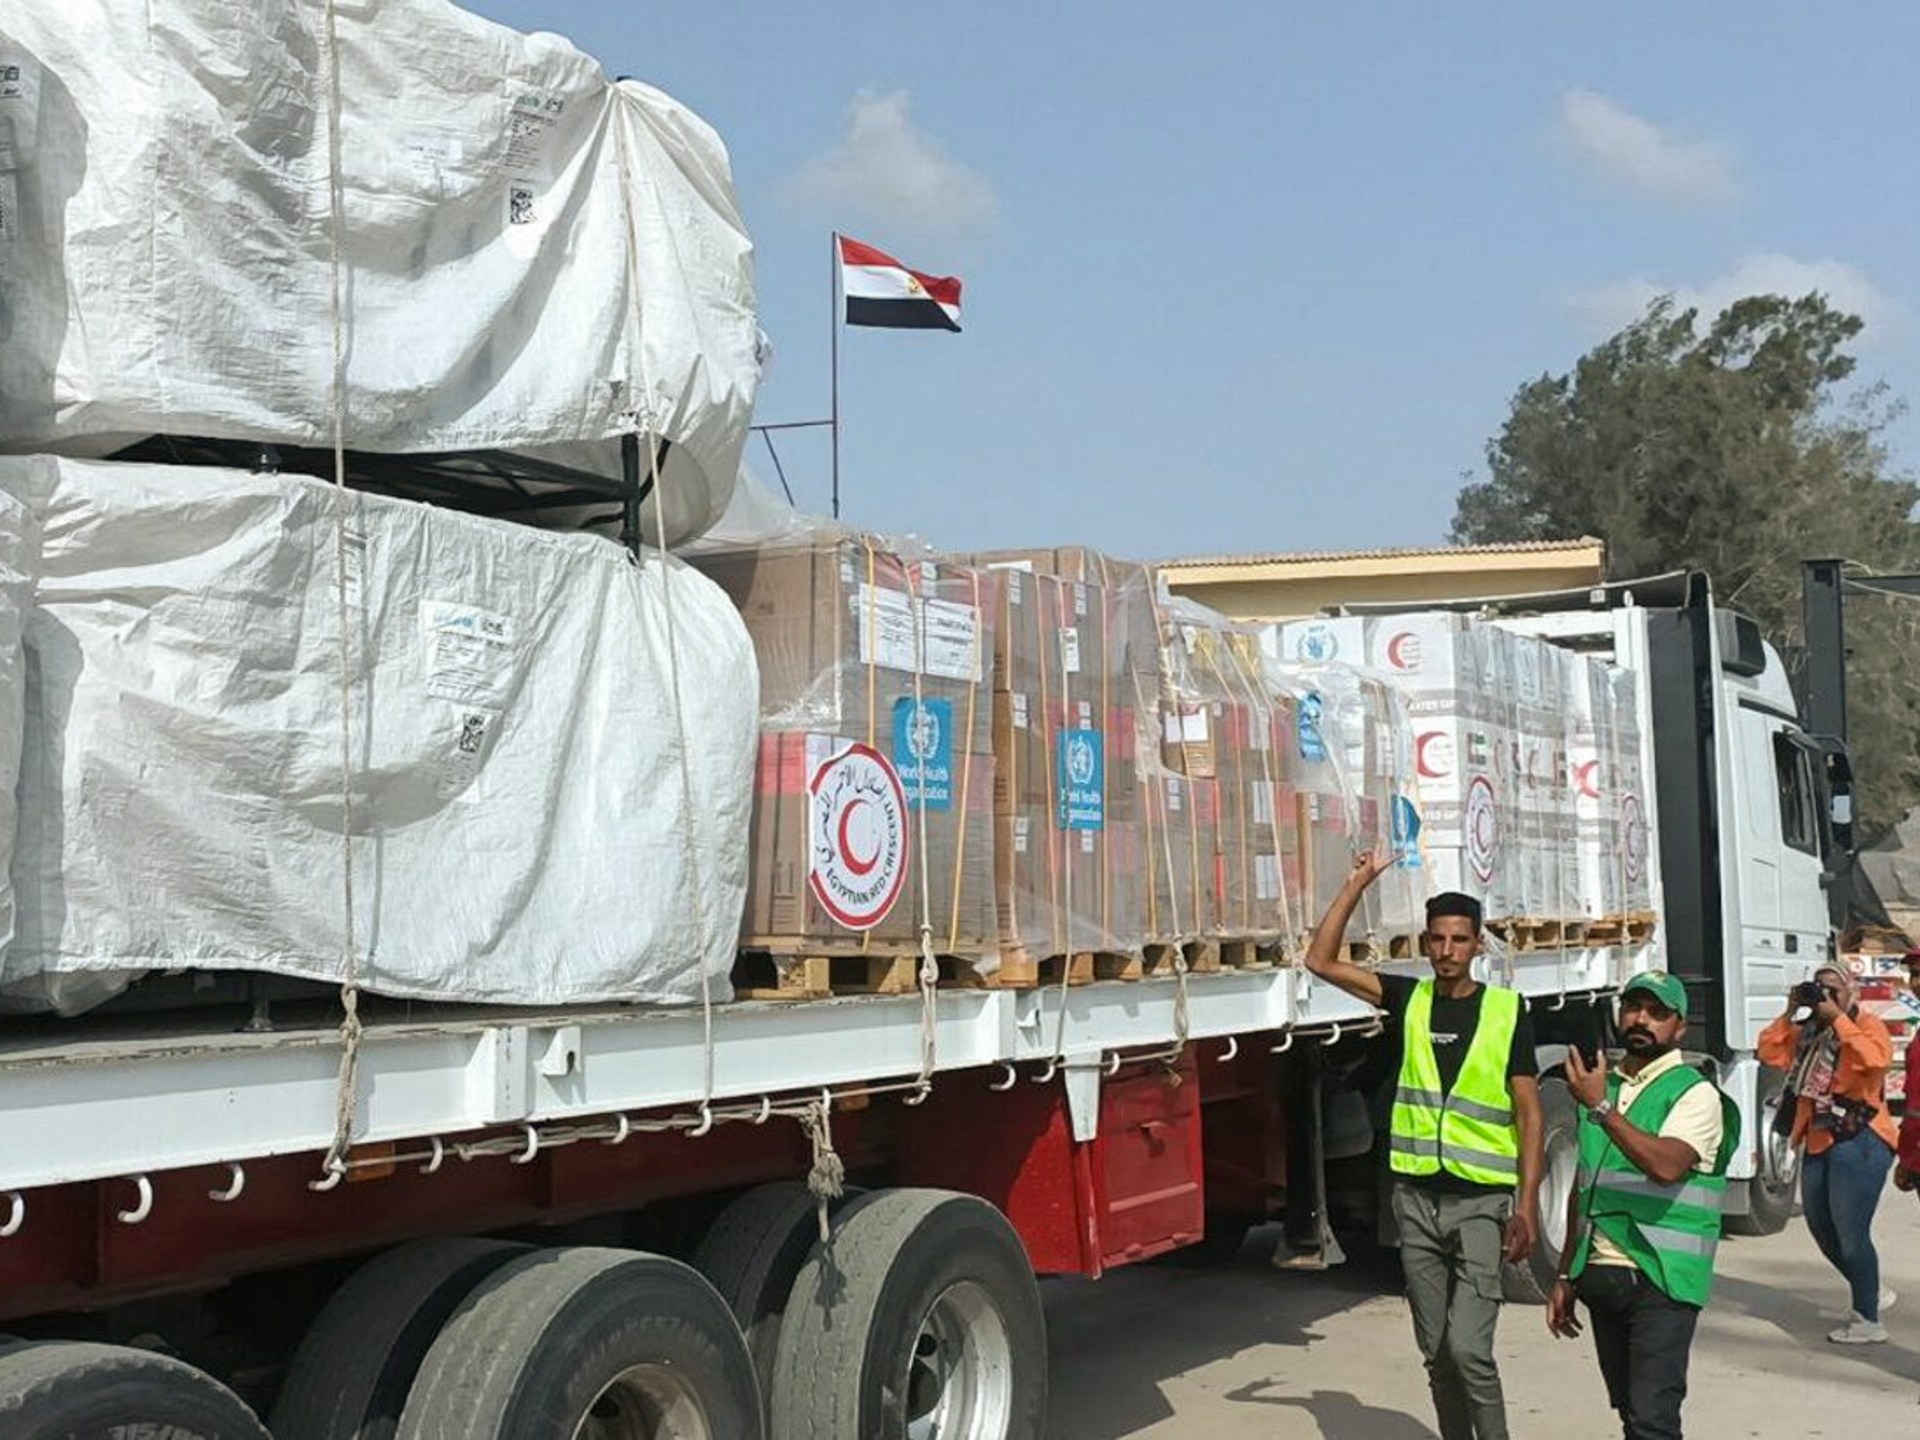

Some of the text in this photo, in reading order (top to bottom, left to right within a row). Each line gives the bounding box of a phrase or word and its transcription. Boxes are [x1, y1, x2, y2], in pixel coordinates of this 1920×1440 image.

[826, 801, 898, 905] EGYPTIAN RED CRESCENT
